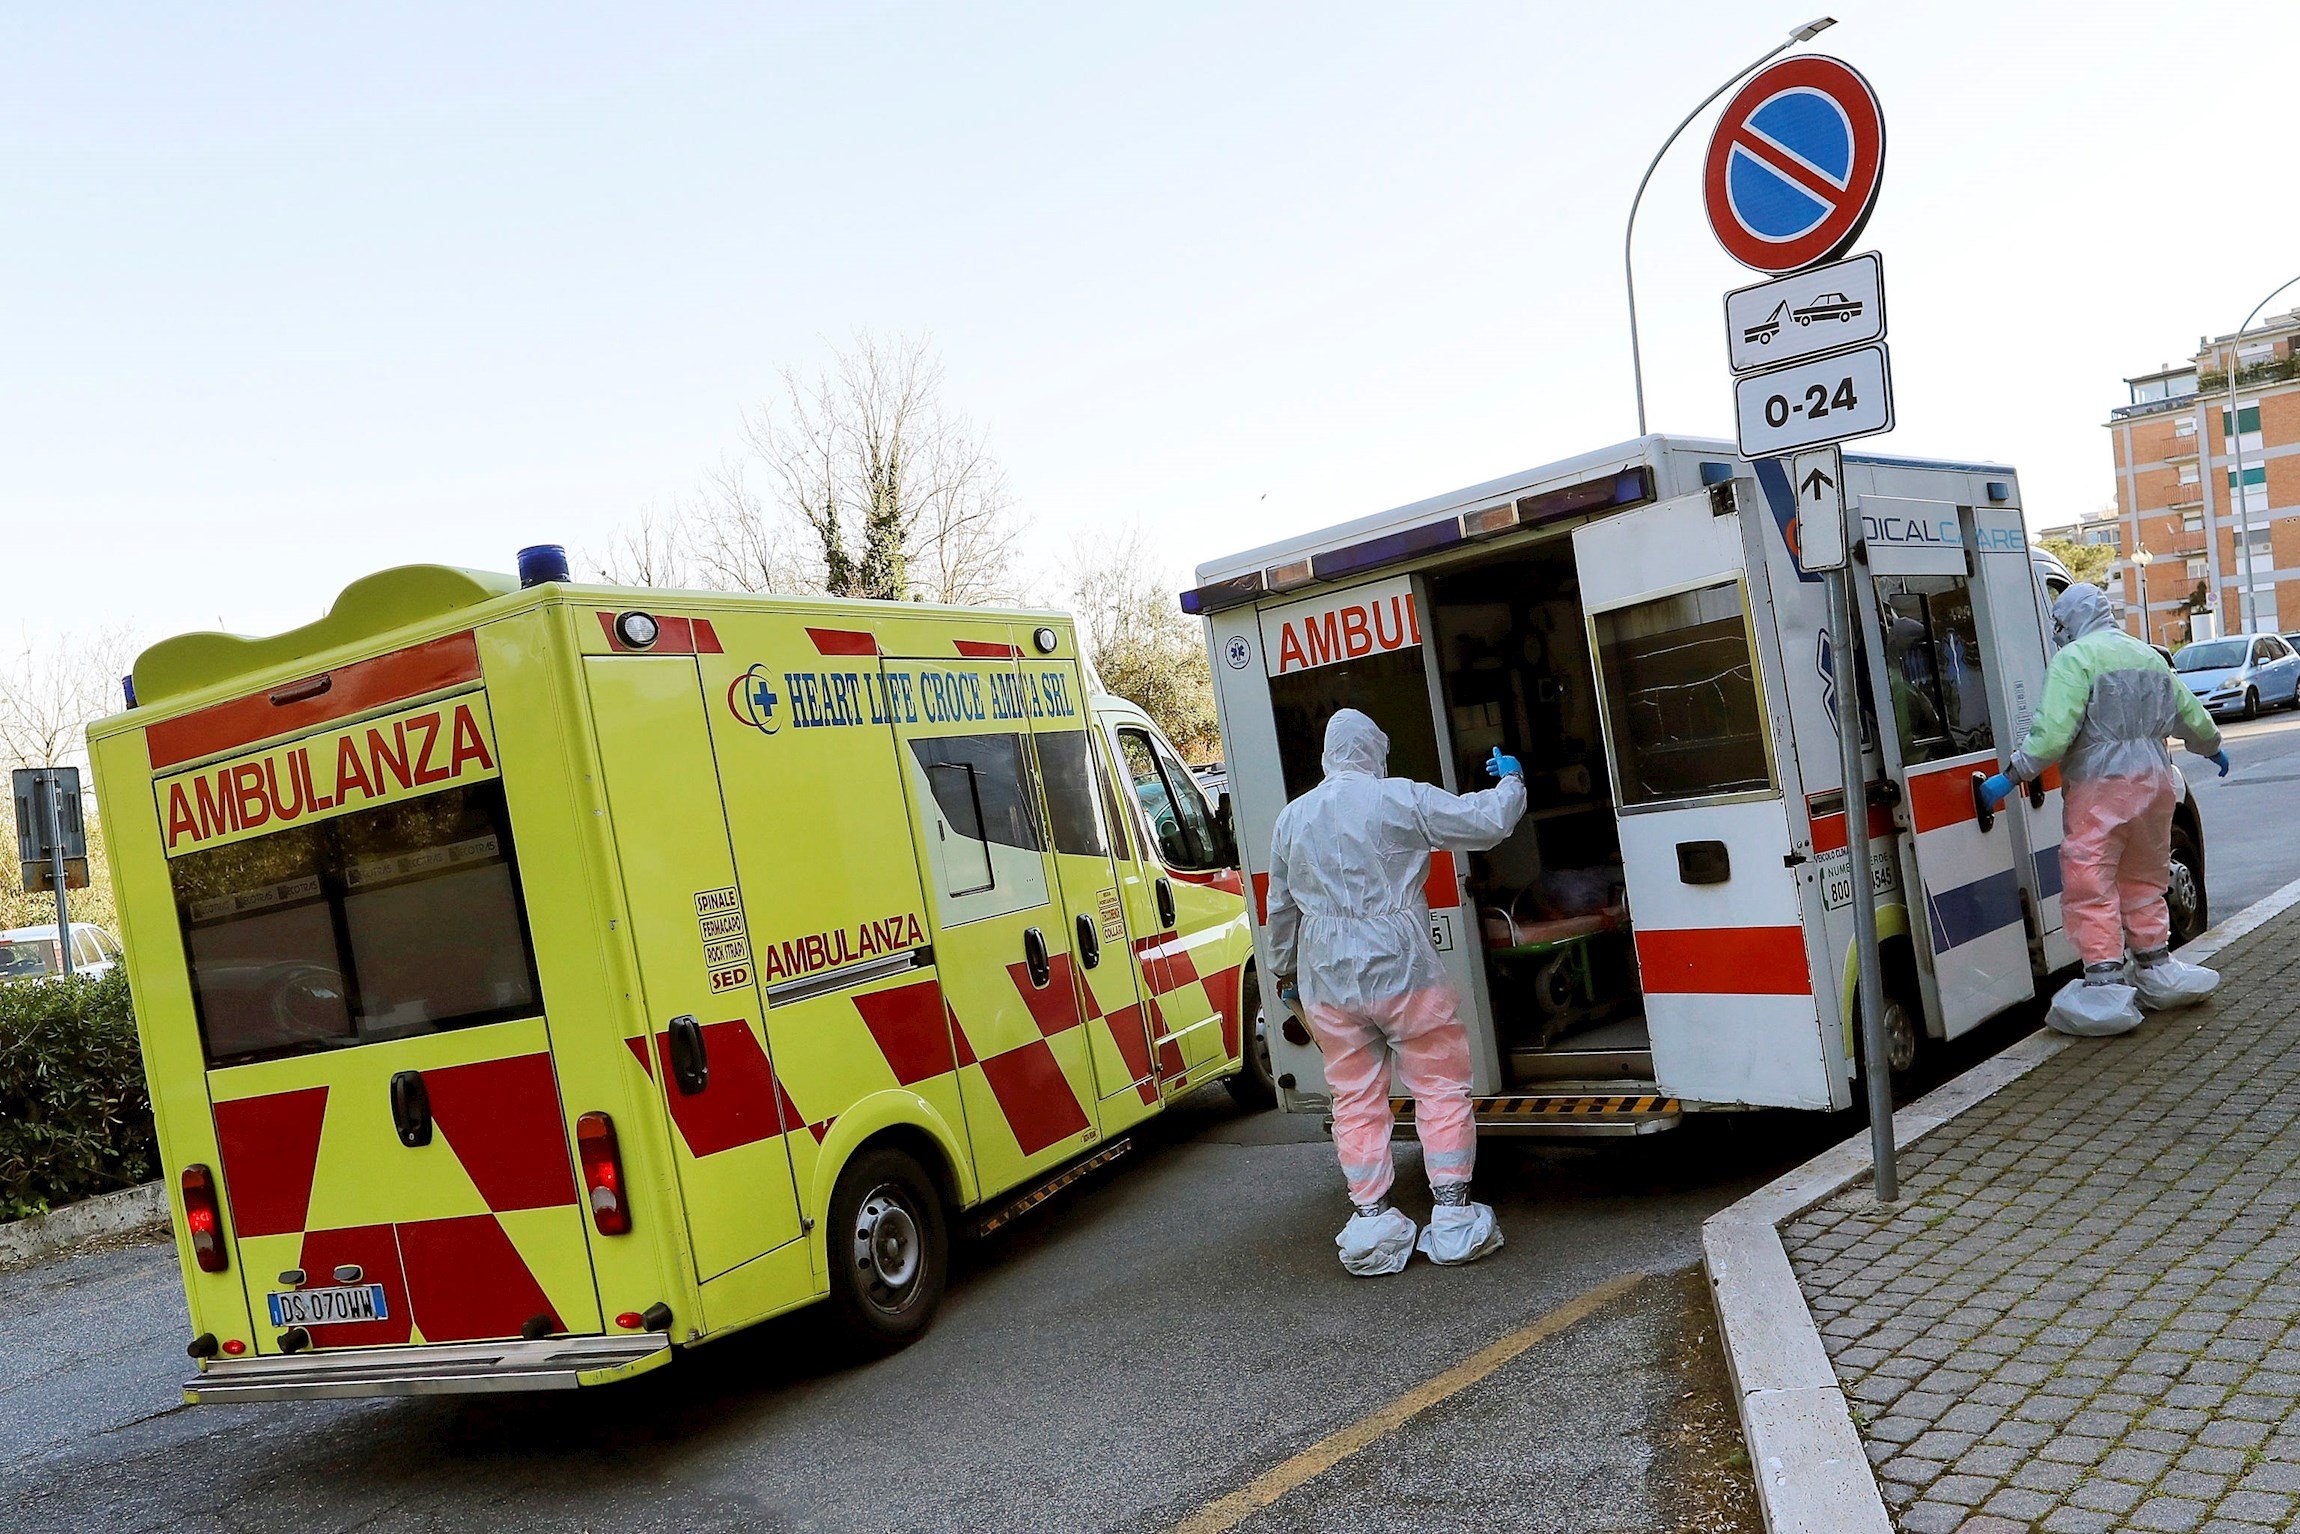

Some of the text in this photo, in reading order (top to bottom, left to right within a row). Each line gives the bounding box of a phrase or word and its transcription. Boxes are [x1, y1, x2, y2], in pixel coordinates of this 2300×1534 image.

[1765, 377, 1858, 428] 0-24
[785, 673, 863, 727] HEART
[864, 673, 917, 724] LIFE
[920, 671, 985, 723] CROCE
[1042, 672, 1074, 717] SRL
[169, 704, 494, 848] AMBULANZA
[698, 891, 735, 912] SPINALE
[767, 913, 924, 982] AMBULANZA
[713, 969, 747, 989] SED
[281, 1295, 305, 1322] DS
